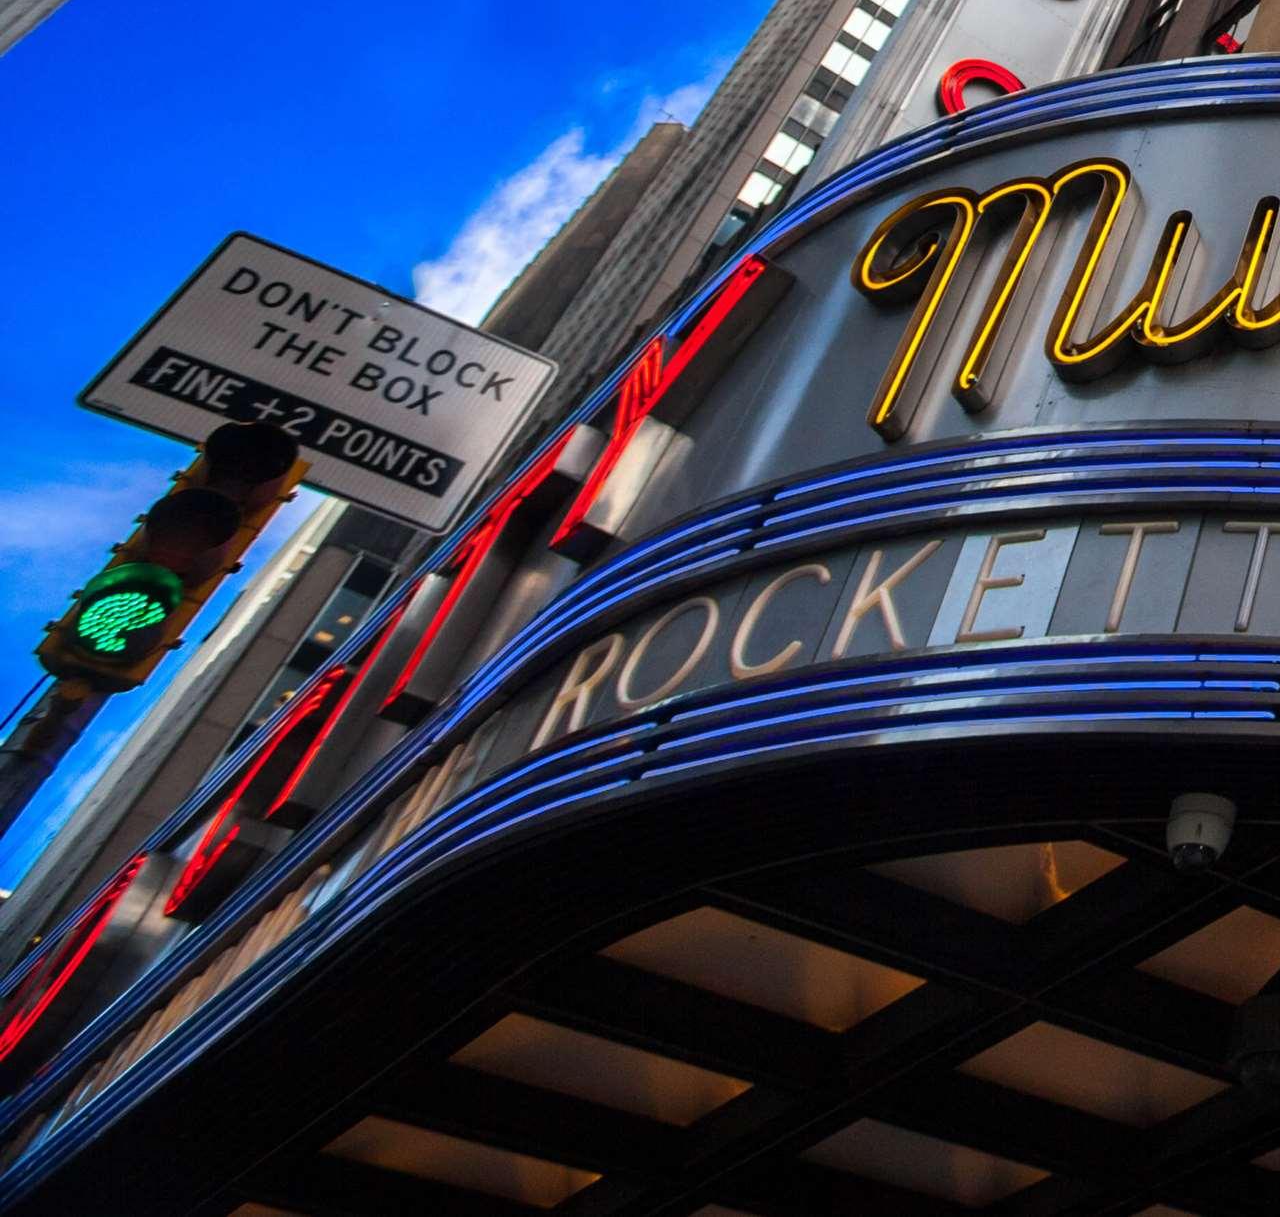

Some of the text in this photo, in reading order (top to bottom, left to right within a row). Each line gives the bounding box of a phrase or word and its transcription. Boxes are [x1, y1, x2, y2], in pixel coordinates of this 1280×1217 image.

[221, 266, 515, 403] DON'T BLOCK
[253, 321, 444, 416] THE BOX
[147, 356, 447, 486] FINE +2 POINTS
